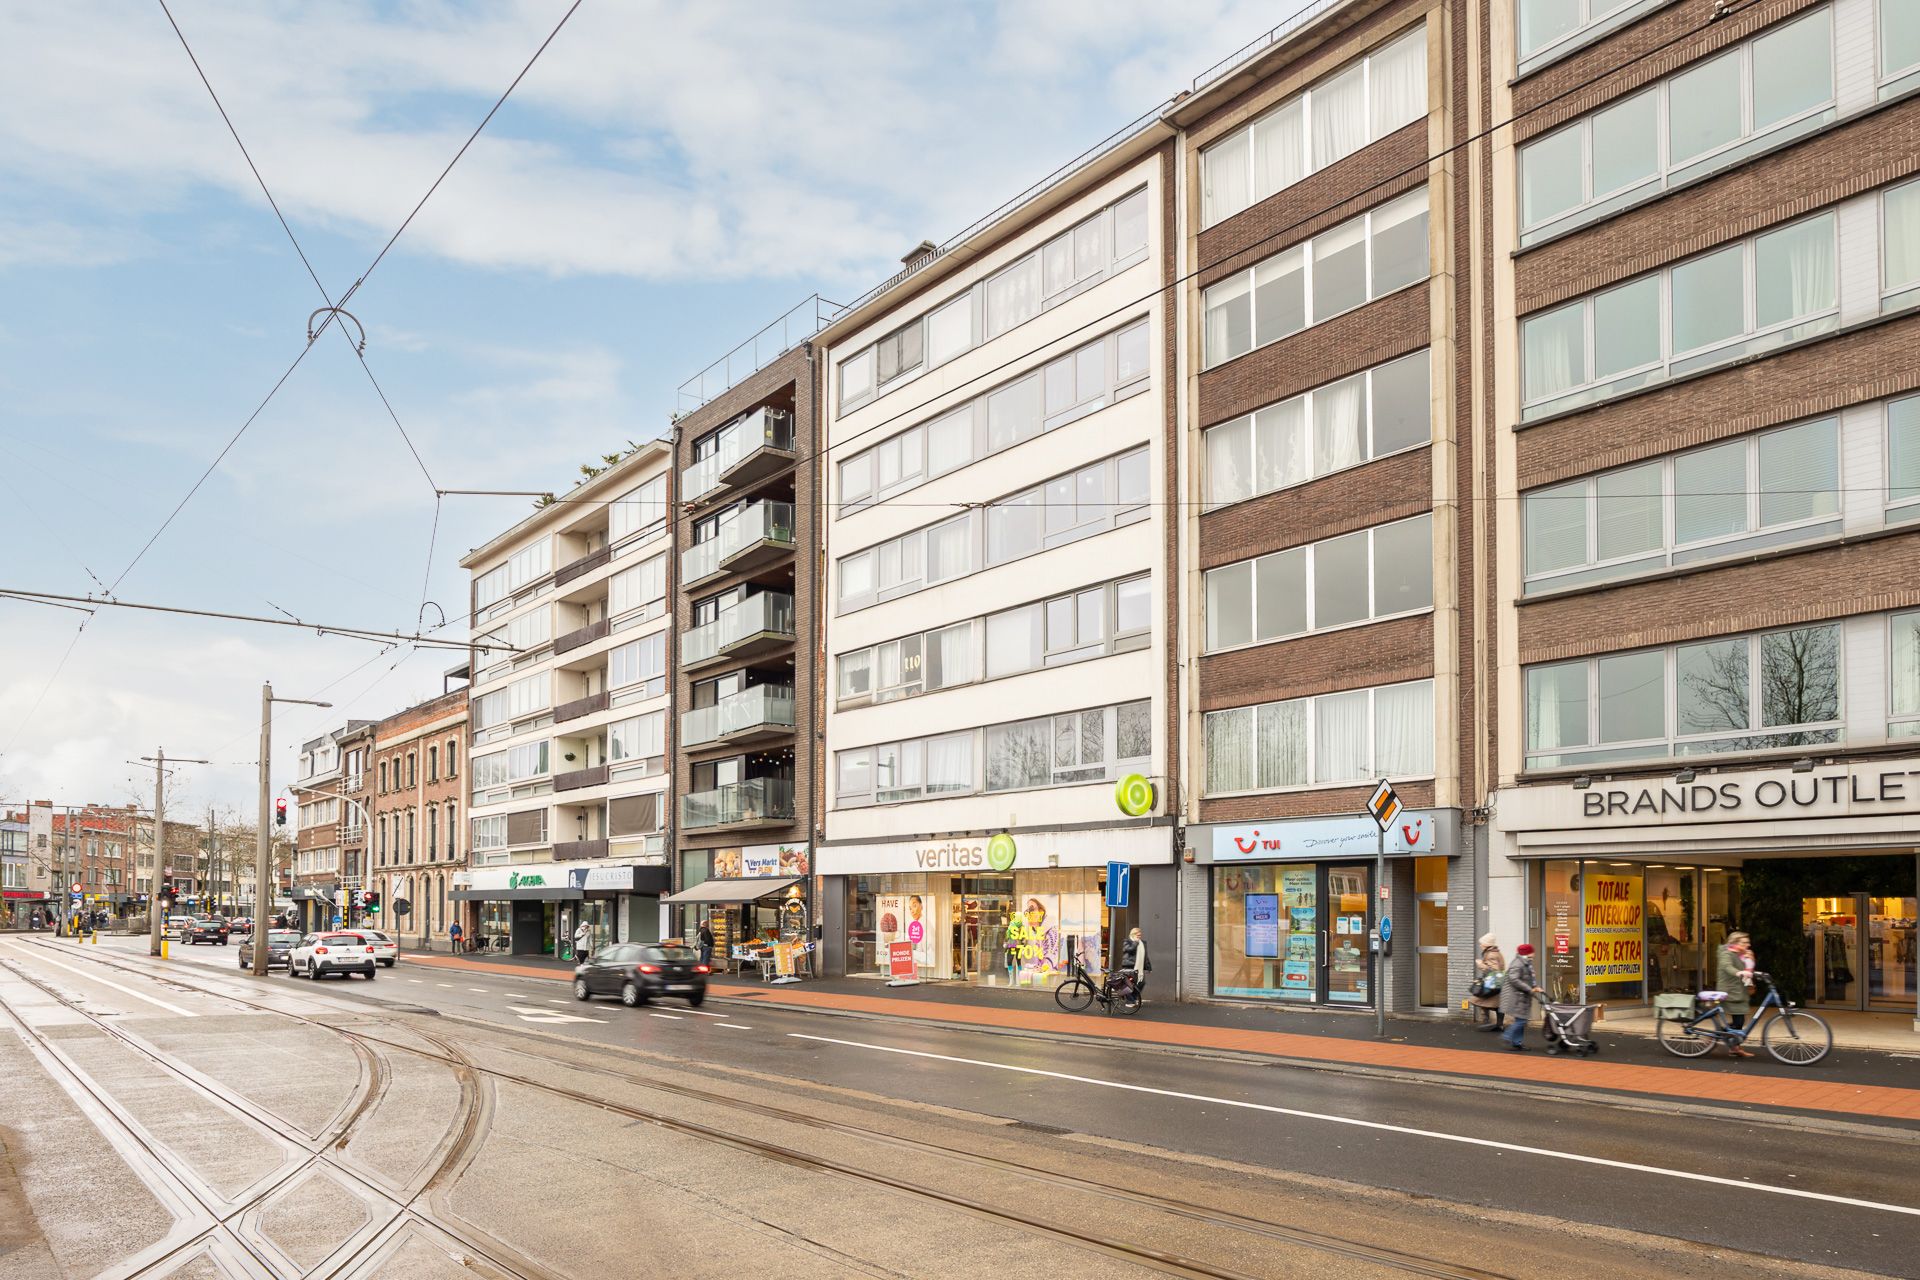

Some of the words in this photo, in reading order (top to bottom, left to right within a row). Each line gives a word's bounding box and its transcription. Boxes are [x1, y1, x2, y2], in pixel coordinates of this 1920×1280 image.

[904, 655, 921, 672] 110
[1583, 782, 1742, 817] BRANDS
[1262, 839, 1281, 850] TUI
[1339, 835, 1356, 848] your
[750, 859, 761, 867] Vers
[762, 858, 778, 866] Markt
[915, 843, 983, 868] veritas
[1597, 880, 1630, 902] TOTALE
[881, 899, 899, 908] HAVE
[1585, 904, 1641, 926] UITVERKOOP
[1010, 926, 1045, 940] SALE
[1011, 944, 1044, 960] -70%
[1613, 940, 1642, 961] EXTRA
[1585, 965, 1607, 976] BOVENOP
[1607, 963, 1641, 975] OUTLETPRIJZEN
